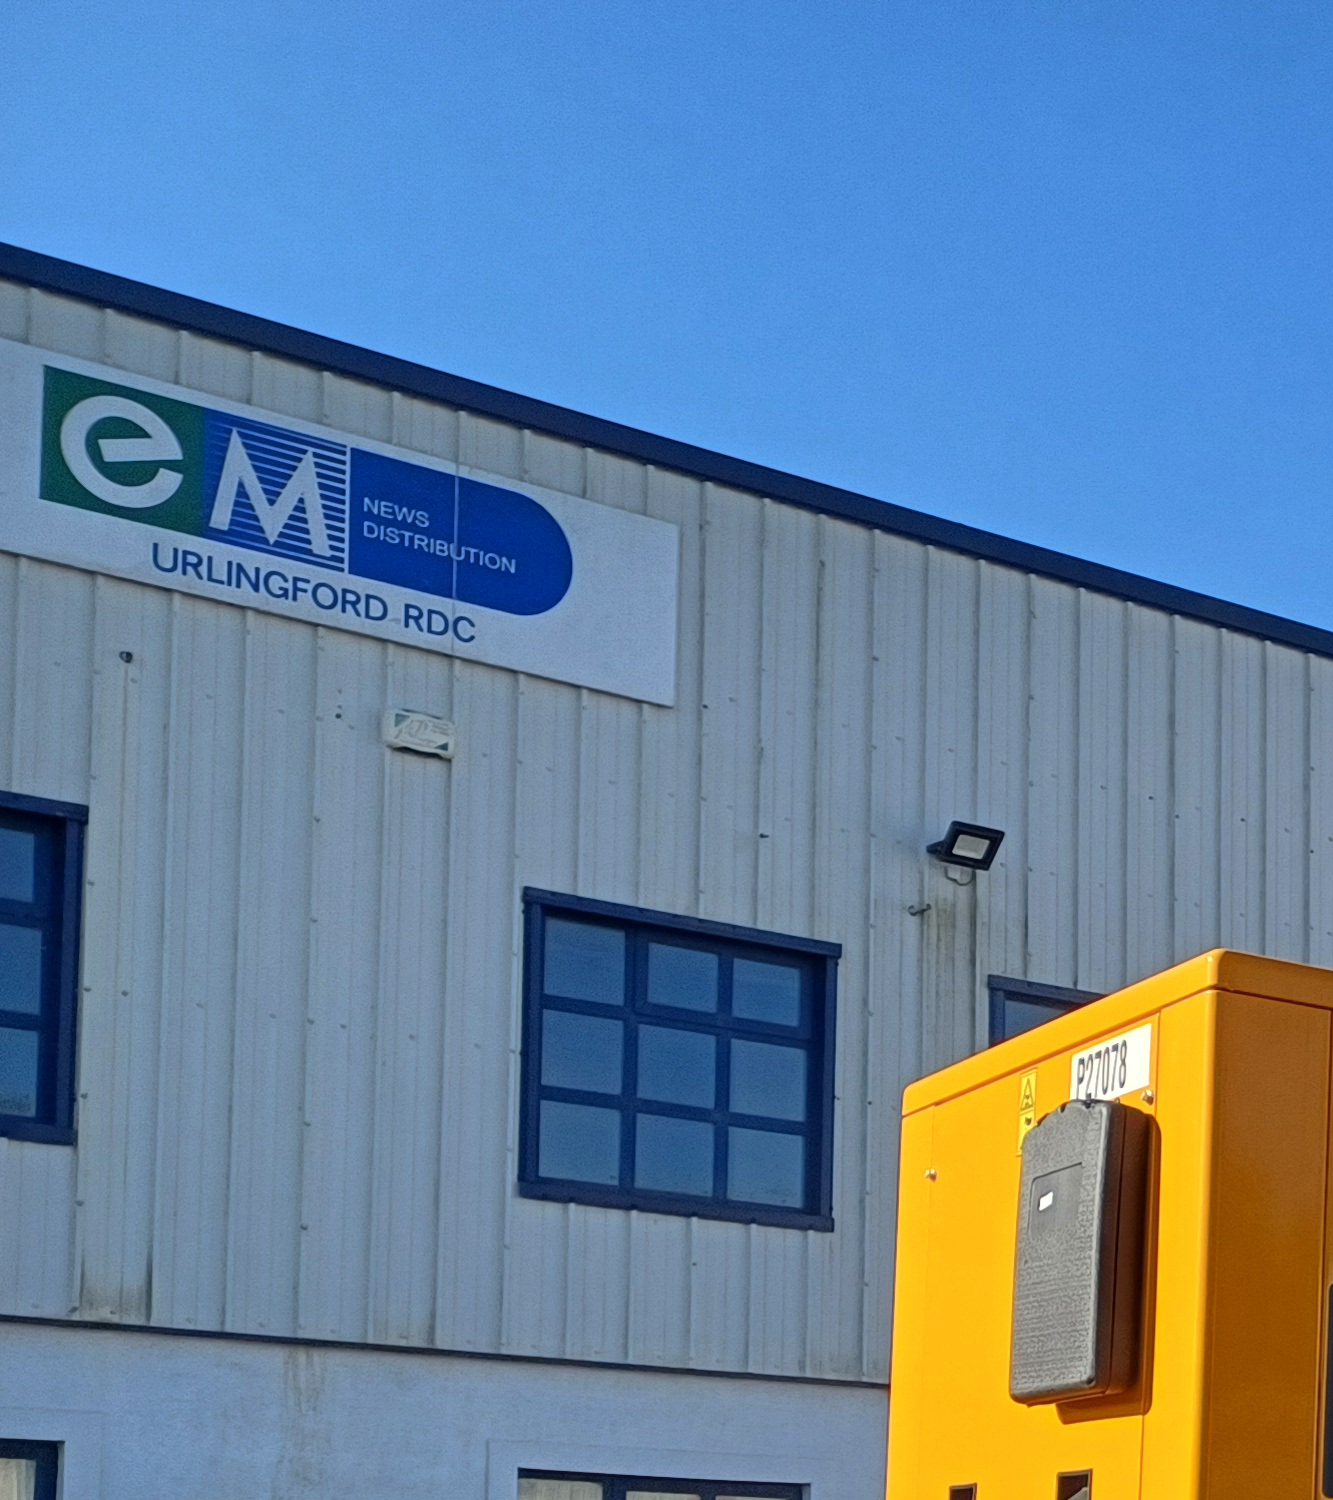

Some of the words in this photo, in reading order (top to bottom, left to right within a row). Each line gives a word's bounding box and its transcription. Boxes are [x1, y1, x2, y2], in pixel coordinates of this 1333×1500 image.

[363, 496, 430, 528] NEWS
[363, 520, 516, 574] DISTRIBUTION
[151, 542, 389, 623] URLINGFORD
[403, 603, 476, 644] RDC
[1076, 1039, 1128, 1099] P27078
